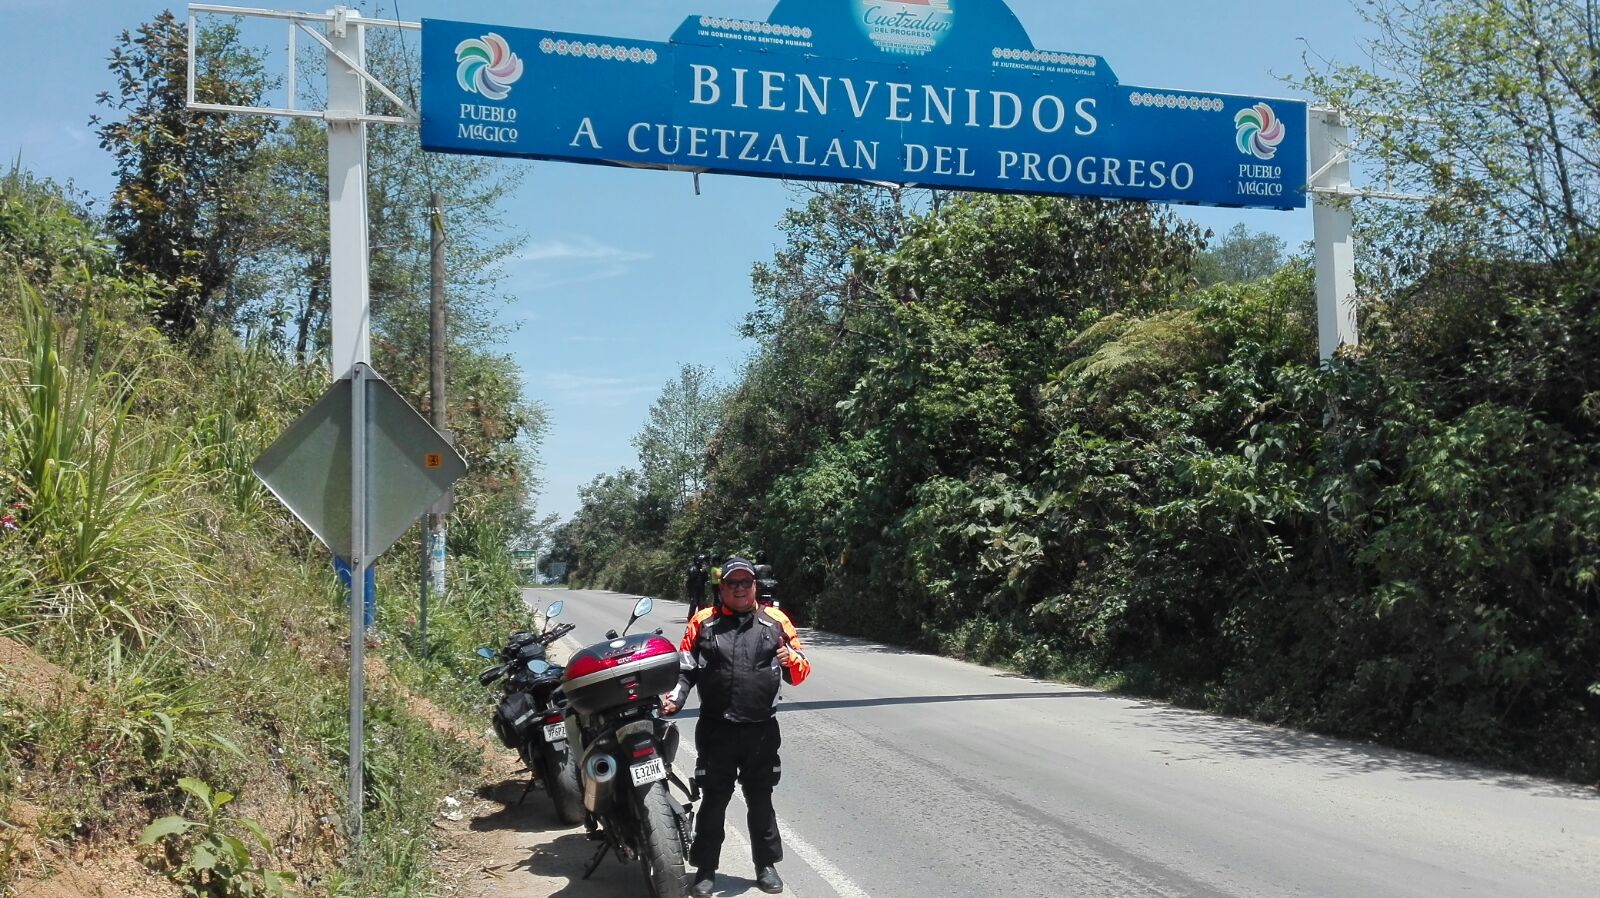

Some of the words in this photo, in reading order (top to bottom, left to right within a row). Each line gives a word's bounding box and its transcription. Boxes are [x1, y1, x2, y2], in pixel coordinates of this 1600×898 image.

[864, 6, 950, 32] Cuetzalan
[711, 31, 742, 40] GOBIERNO
[743, 34, 756, 42] CON
[758, 36, 784, 45] SENTIDO
[890, 29, 931, 38] PROGRESO
[689, 63, 1098, 136] BIENVENIDOS
[569, 117, 603, 149] A
[627, 122, 880, 170] CUETZALAN
[903, 143, 976, 177] DEL
[997, 150, 1194, 190] PROGRESO
[634, 763, 661, 780] E32HK
